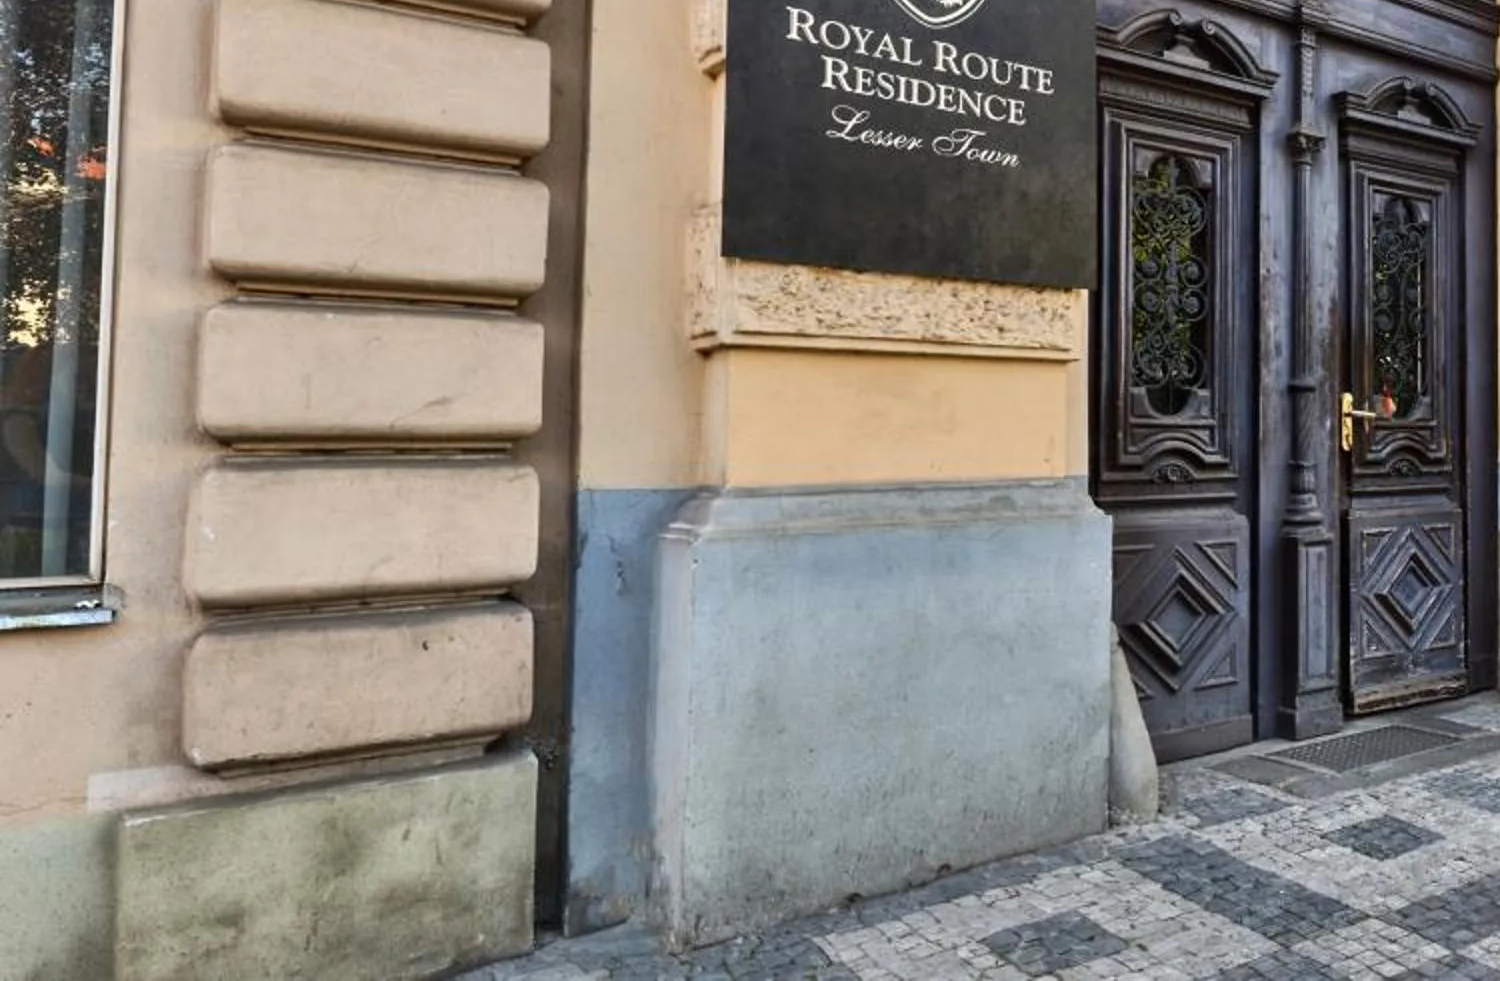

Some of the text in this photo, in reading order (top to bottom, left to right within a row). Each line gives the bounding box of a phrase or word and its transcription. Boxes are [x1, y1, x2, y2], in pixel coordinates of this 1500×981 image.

[786, 6, 1055, 94] ROYAL ROUTE
[820, 54, 1027, 126] RESIDENCE
[825, 104, 1021, 168] Lesser Town
